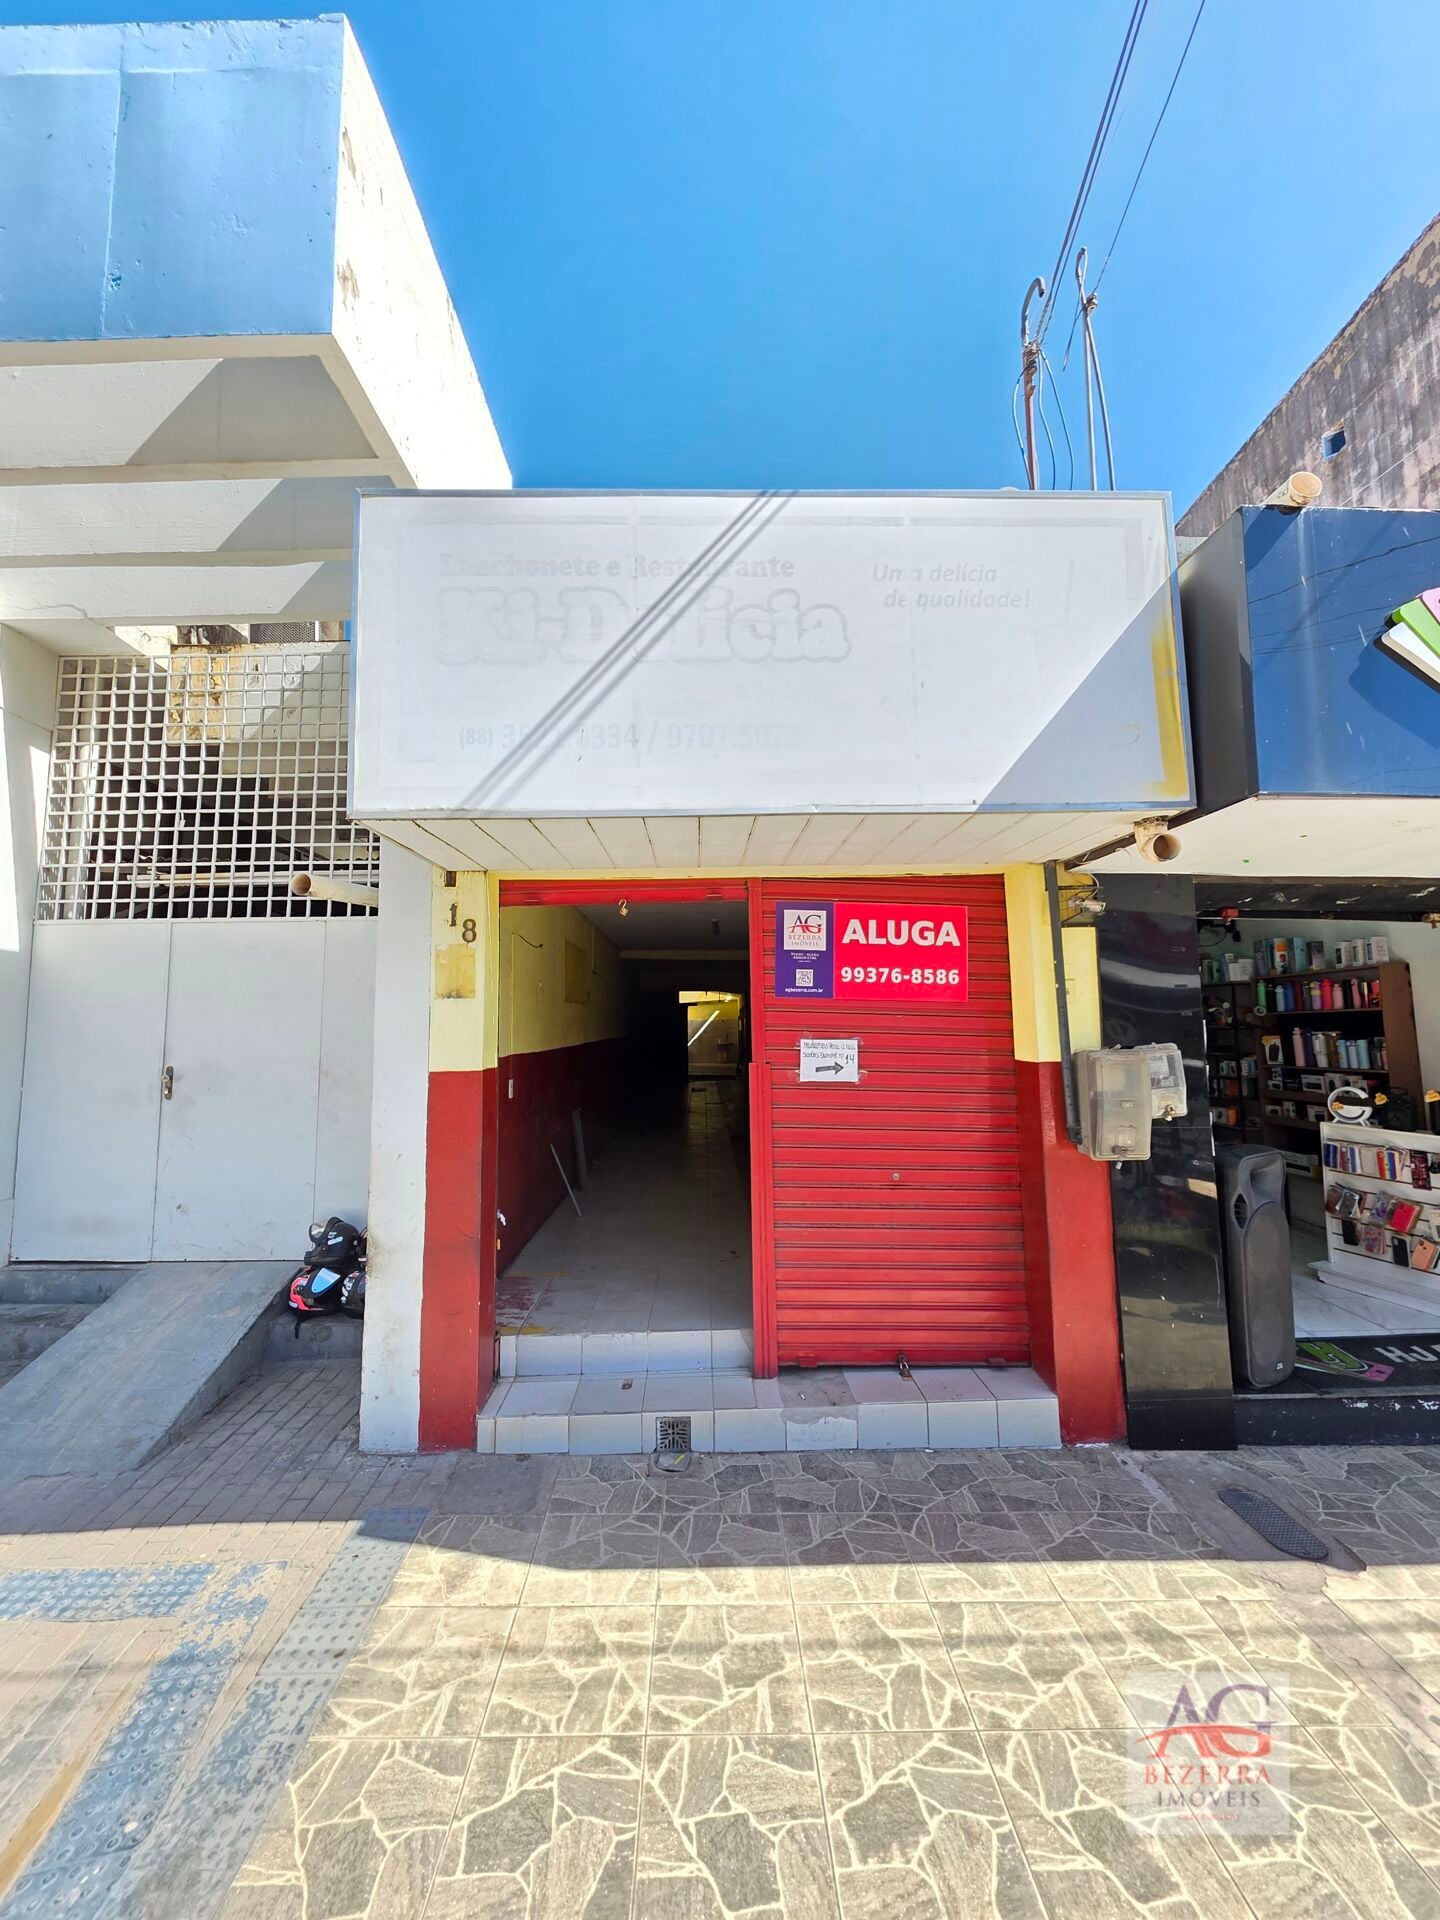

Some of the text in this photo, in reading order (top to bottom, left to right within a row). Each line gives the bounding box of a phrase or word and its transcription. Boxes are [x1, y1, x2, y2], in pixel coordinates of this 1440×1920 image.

[605, 558, 620, 577] e
[929, 563, 998, 582] delícia
[916, 588, 1031, 612] qualidade!
[449, 902, 477, 944] 18
[788, 913, 823, 934] AG
[841, 918, 961, 947] ALUGA
[841, 966, 960, 985] 99376-8586
[845, 1053, 855, 1065] 14
